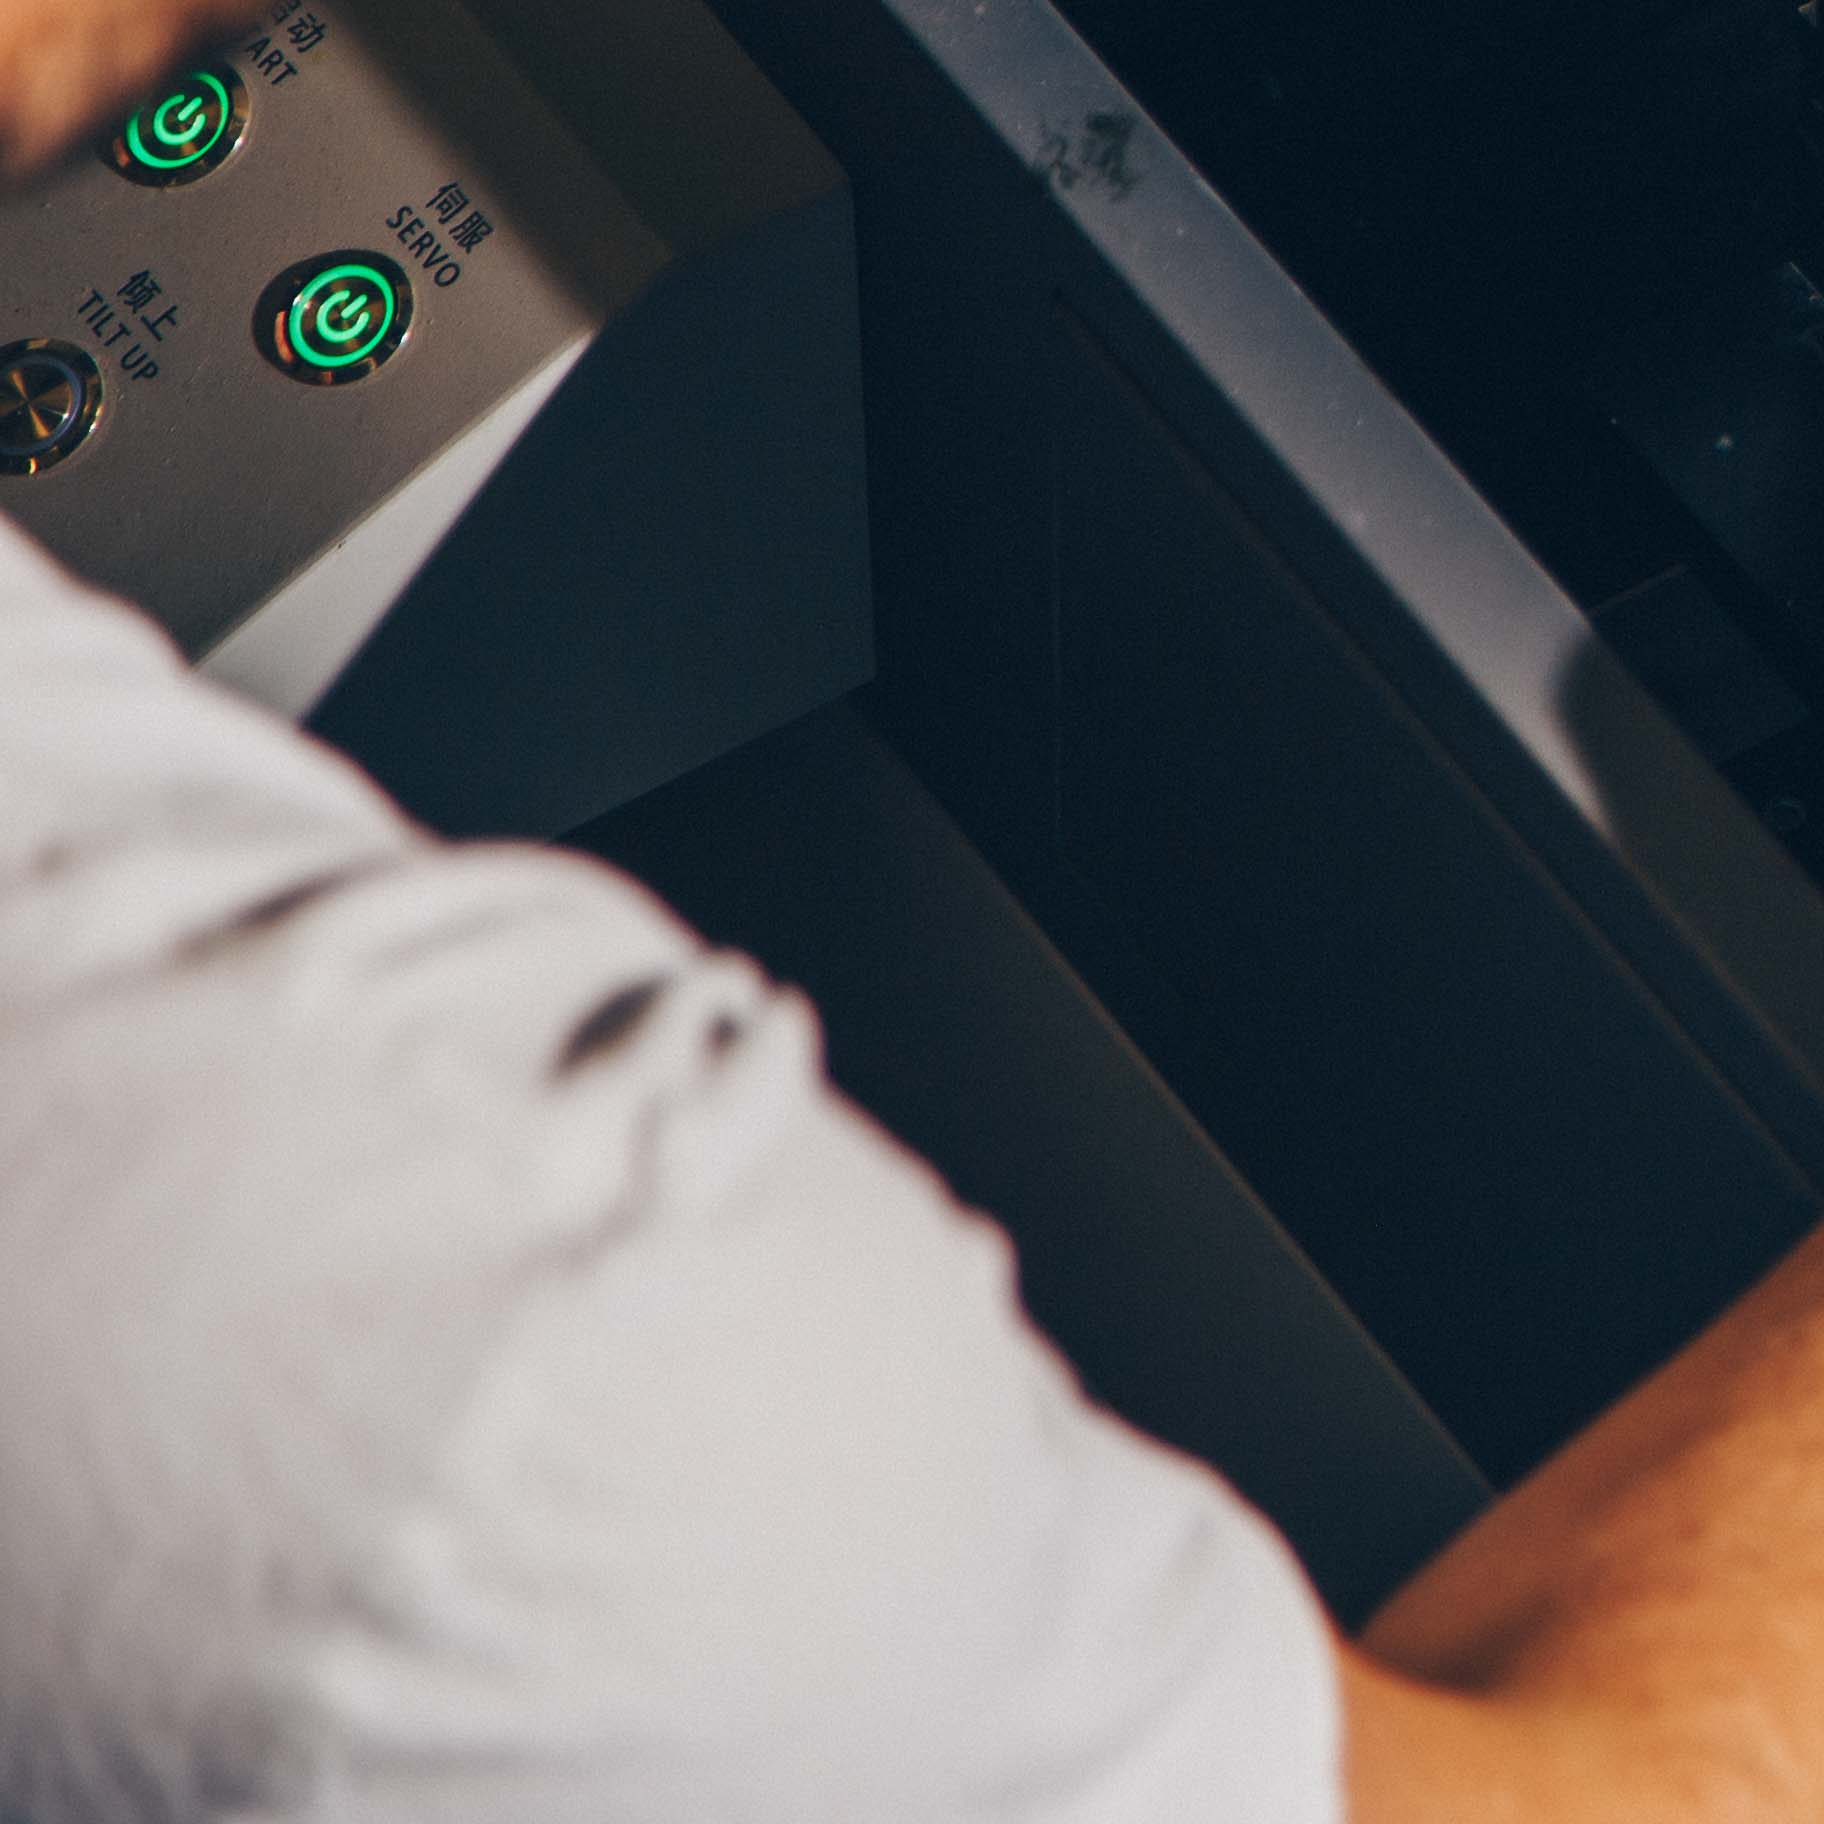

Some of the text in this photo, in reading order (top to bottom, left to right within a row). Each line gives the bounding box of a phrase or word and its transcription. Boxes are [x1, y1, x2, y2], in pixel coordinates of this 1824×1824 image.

[244, 30, 299, 85] ART
[385, 205, 461, 288] SERVO
[425, 181, 494, 255] 伺服
[77, 288, 160, 381] TILT UP
